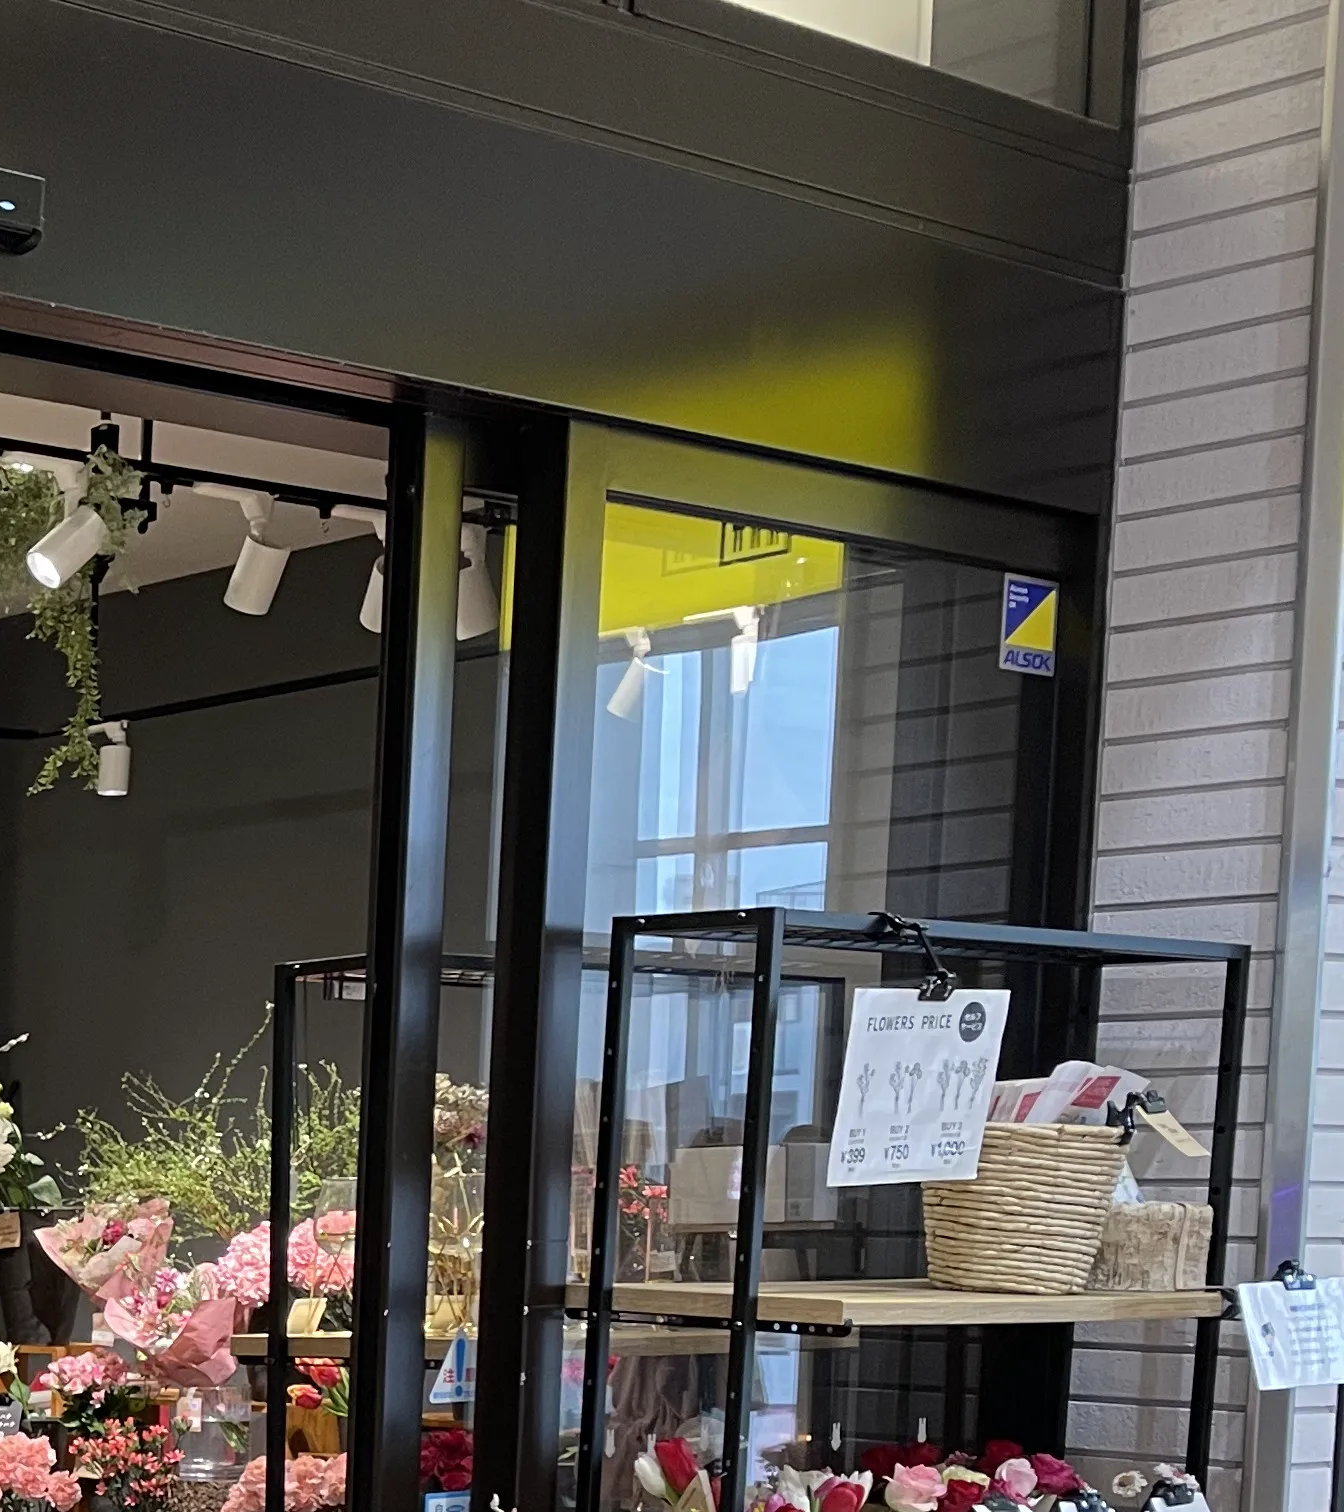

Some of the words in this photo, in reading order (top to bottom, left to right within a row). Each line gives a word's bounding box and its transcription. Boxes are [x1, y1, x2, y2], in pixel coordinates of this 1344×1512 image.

[1003, 649, 1052, 672] ALSOK
[866, 1015, 915, 1033] FLOWERS
[920, 1013, 953, 1030] PRICE
[840, 1147, 866, 1165] ¥399
[884, 1143, 910, 1161] ¥750
